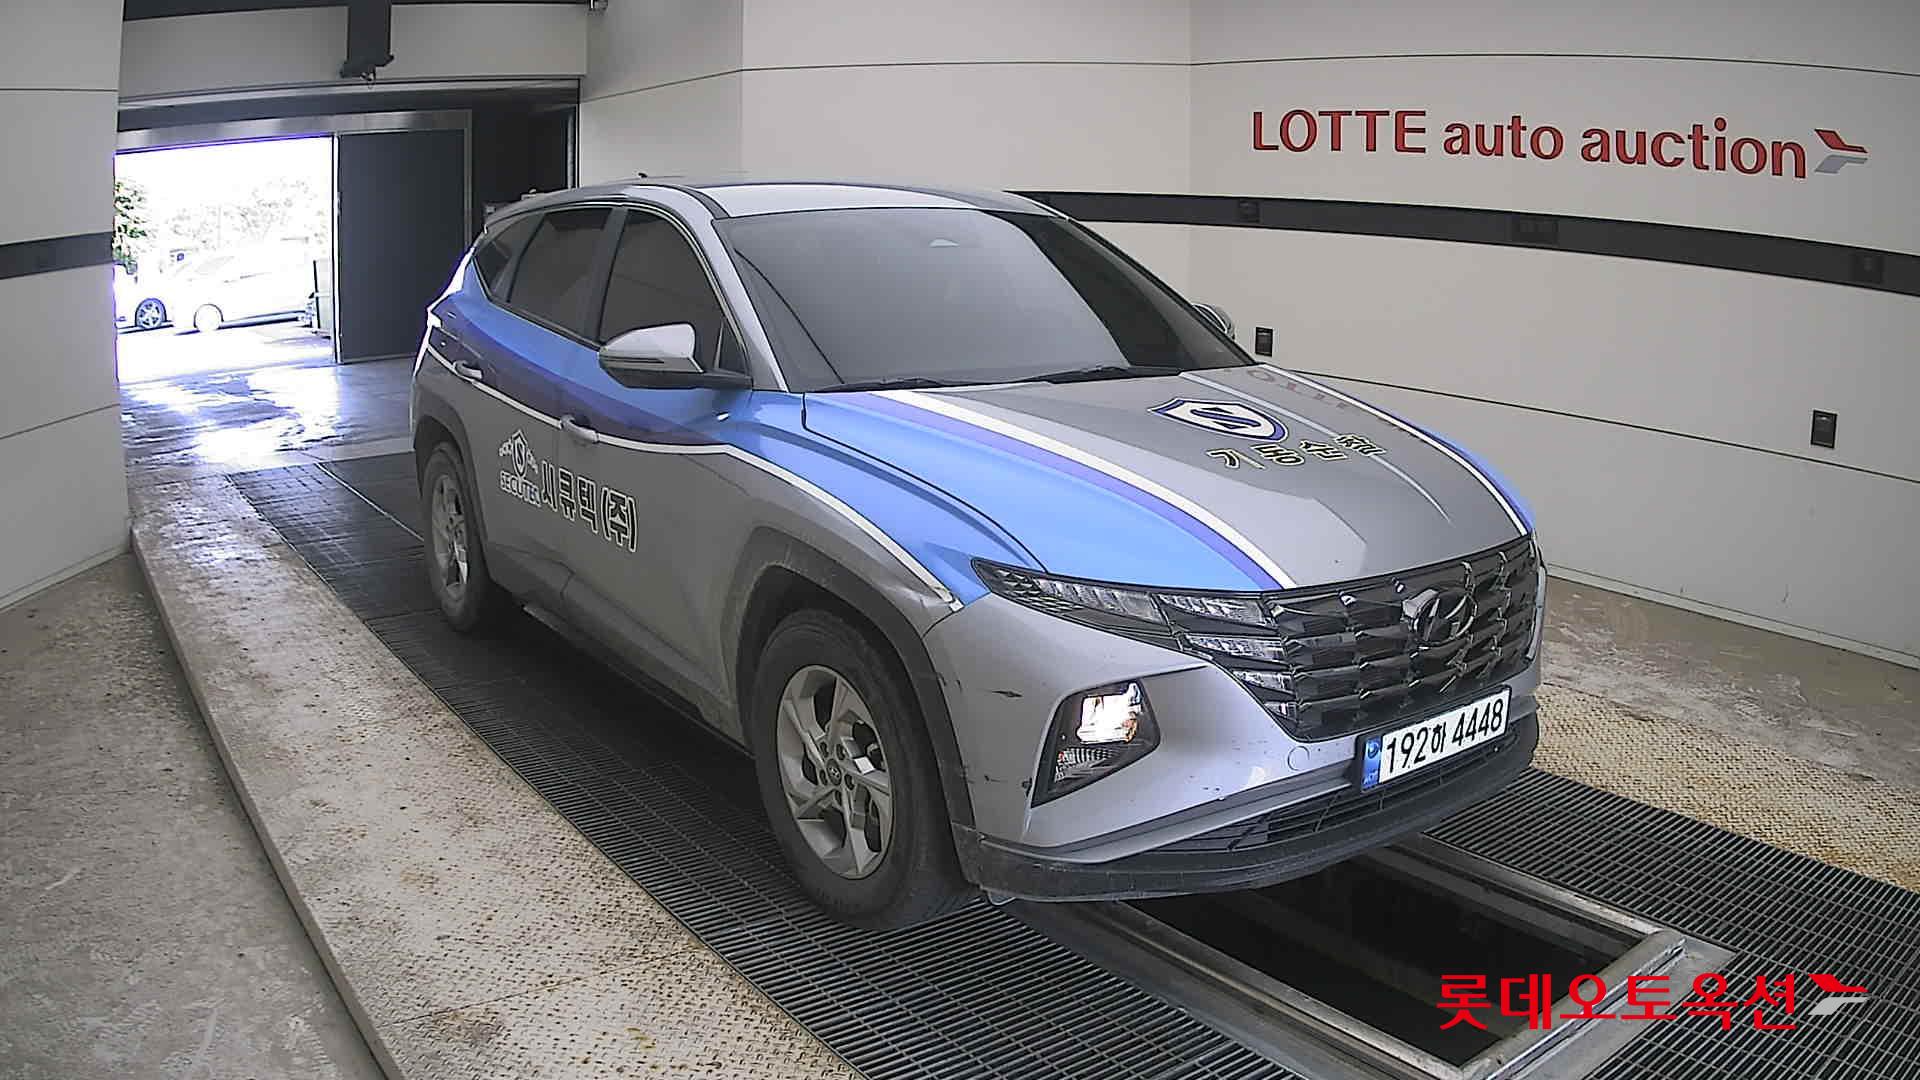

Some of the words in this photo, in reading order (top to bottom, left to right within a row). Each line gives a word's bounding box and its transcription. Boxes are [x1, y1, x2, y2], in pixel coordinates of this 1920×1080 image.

[1252, 110, 1427, 154] LOTTE
[1443, 114, 1564, 160] auto
[1580, 117, 1807, 179] auction
[1206, 434, 1387, 470] 기동순찰
[541, 460, 638, 553] 시큐텍(주)
[1386, 721, 1447, 774] 192하
[1451, 698, 1504, 747] 4448
